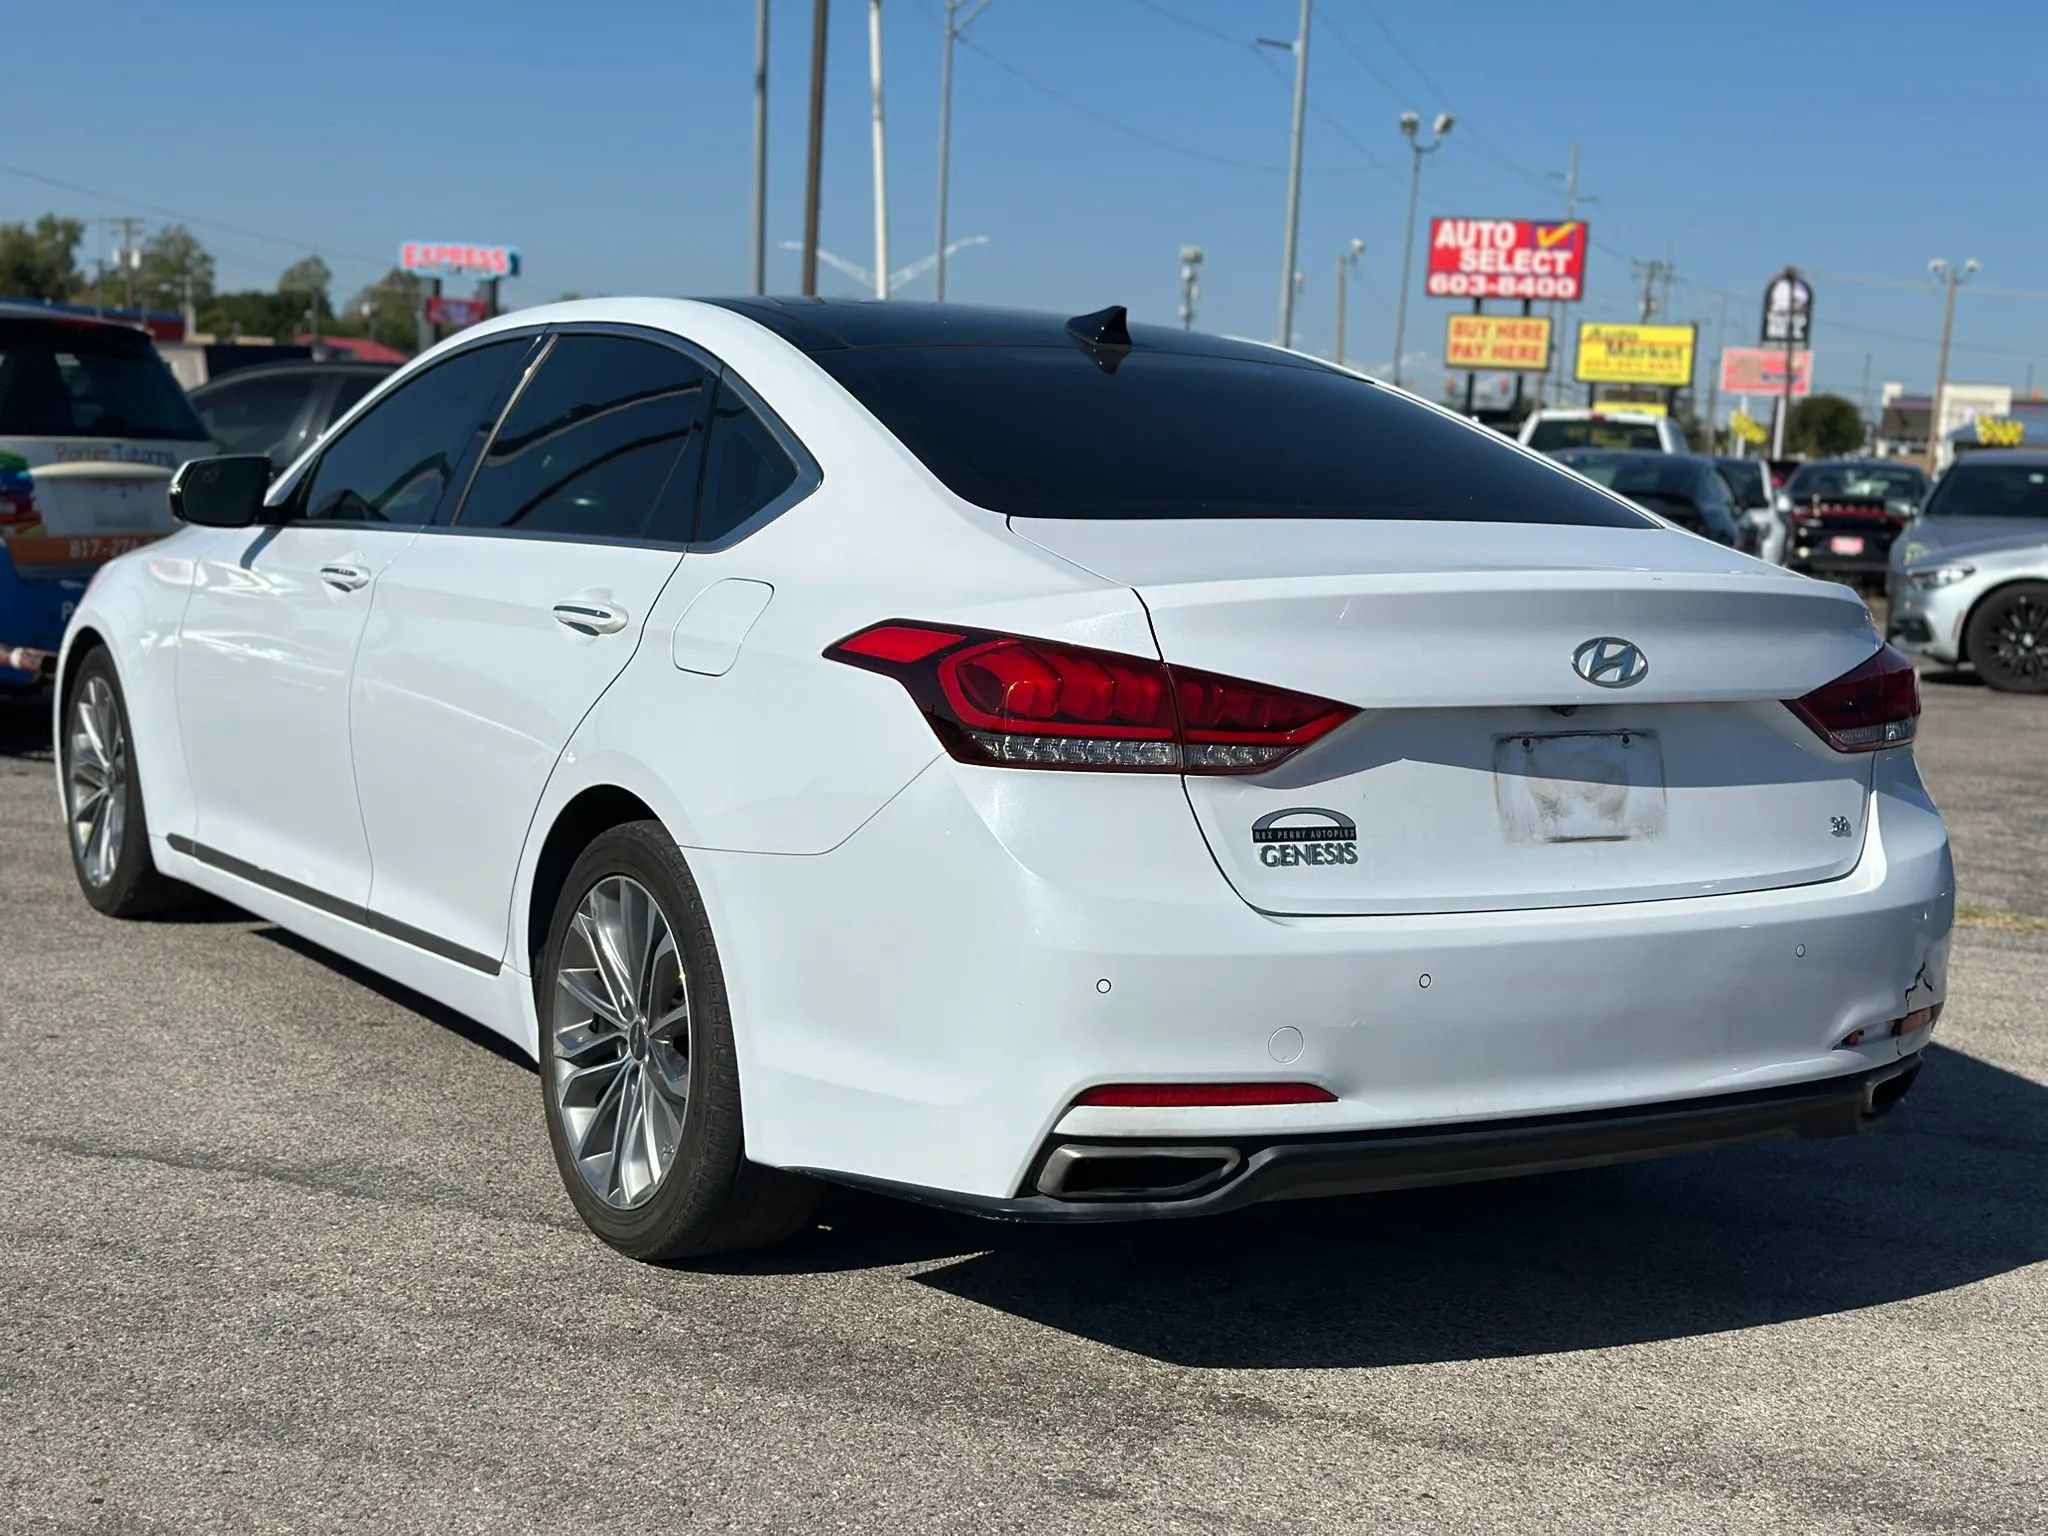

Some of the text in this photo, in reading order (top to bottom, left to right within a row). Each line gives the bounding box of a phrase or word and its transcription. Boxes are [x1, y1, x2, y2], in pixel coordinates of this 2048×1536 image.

[1434, 219, 1517, 249] AUTO
[1459, 248, 1573, 275] SELECT
[1428, 271, 1577, 298] 603-8400
[1454, 321, 1544, 341] BUY HERE
[1451, 343, 1541, 362] PAY HERE
[1255, 829, 1355, 840] REX PERRY AUTOPLEX
[1260, 842, 1358, 867] GENESIS
